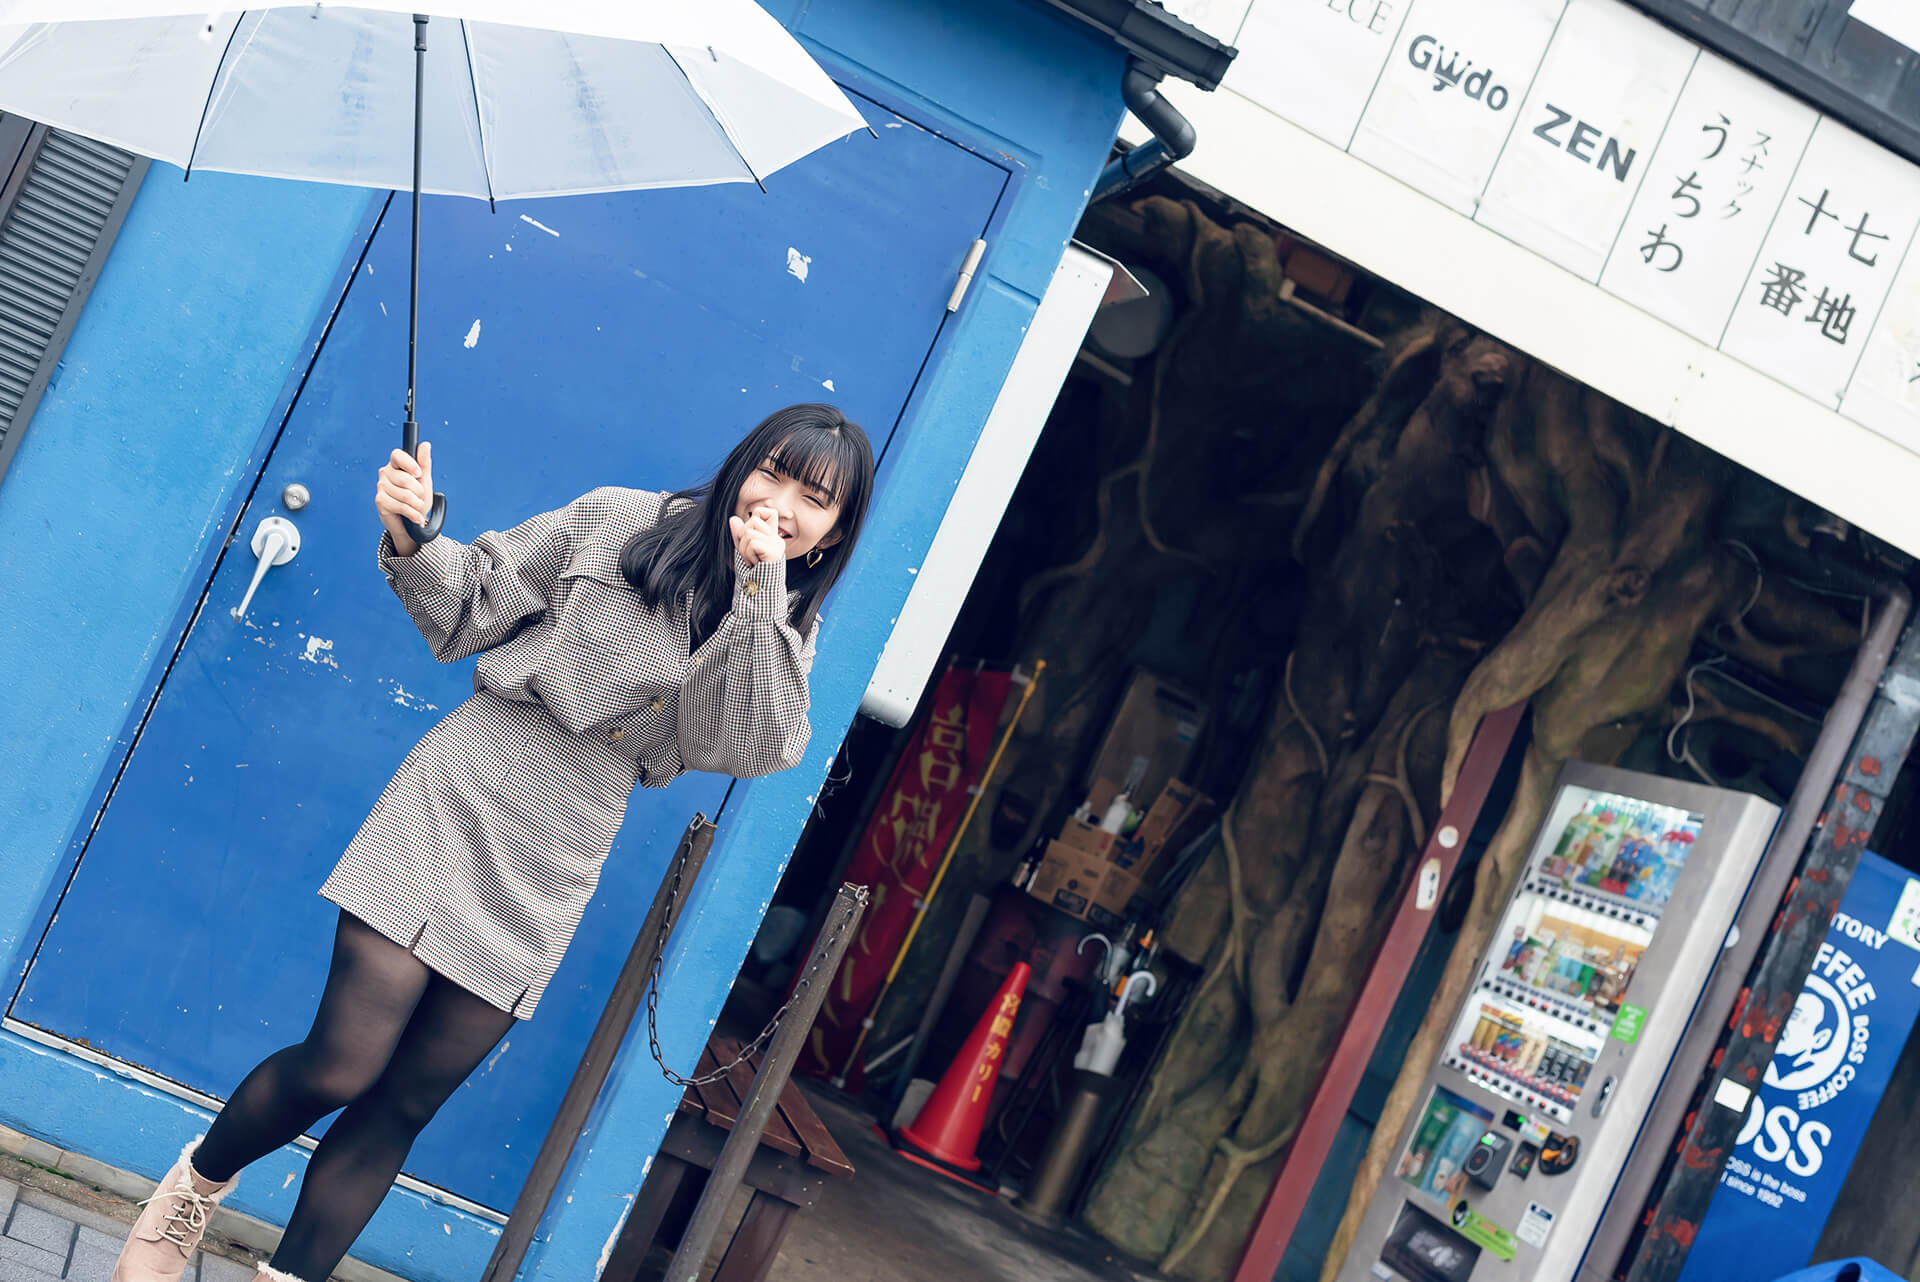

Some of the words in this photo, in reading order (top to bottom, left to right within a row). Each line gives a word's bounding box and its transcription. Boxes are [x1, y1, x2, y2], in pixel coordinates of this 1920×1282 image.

[1533, 103, 1637, 182] ZEN
[1719, 131, 1771, 220] スナック
[1640, 112, 1731, 272] うちわ
[1797, 188, 1890, 267] 十七
[1760, 262, 1857, 345] 番地
[1848, 1014, 1870, 1065] BOSS
[1797, 1064, 1856, 1111] COFFEE
[1779, 1181, 1808, 1203] boss
